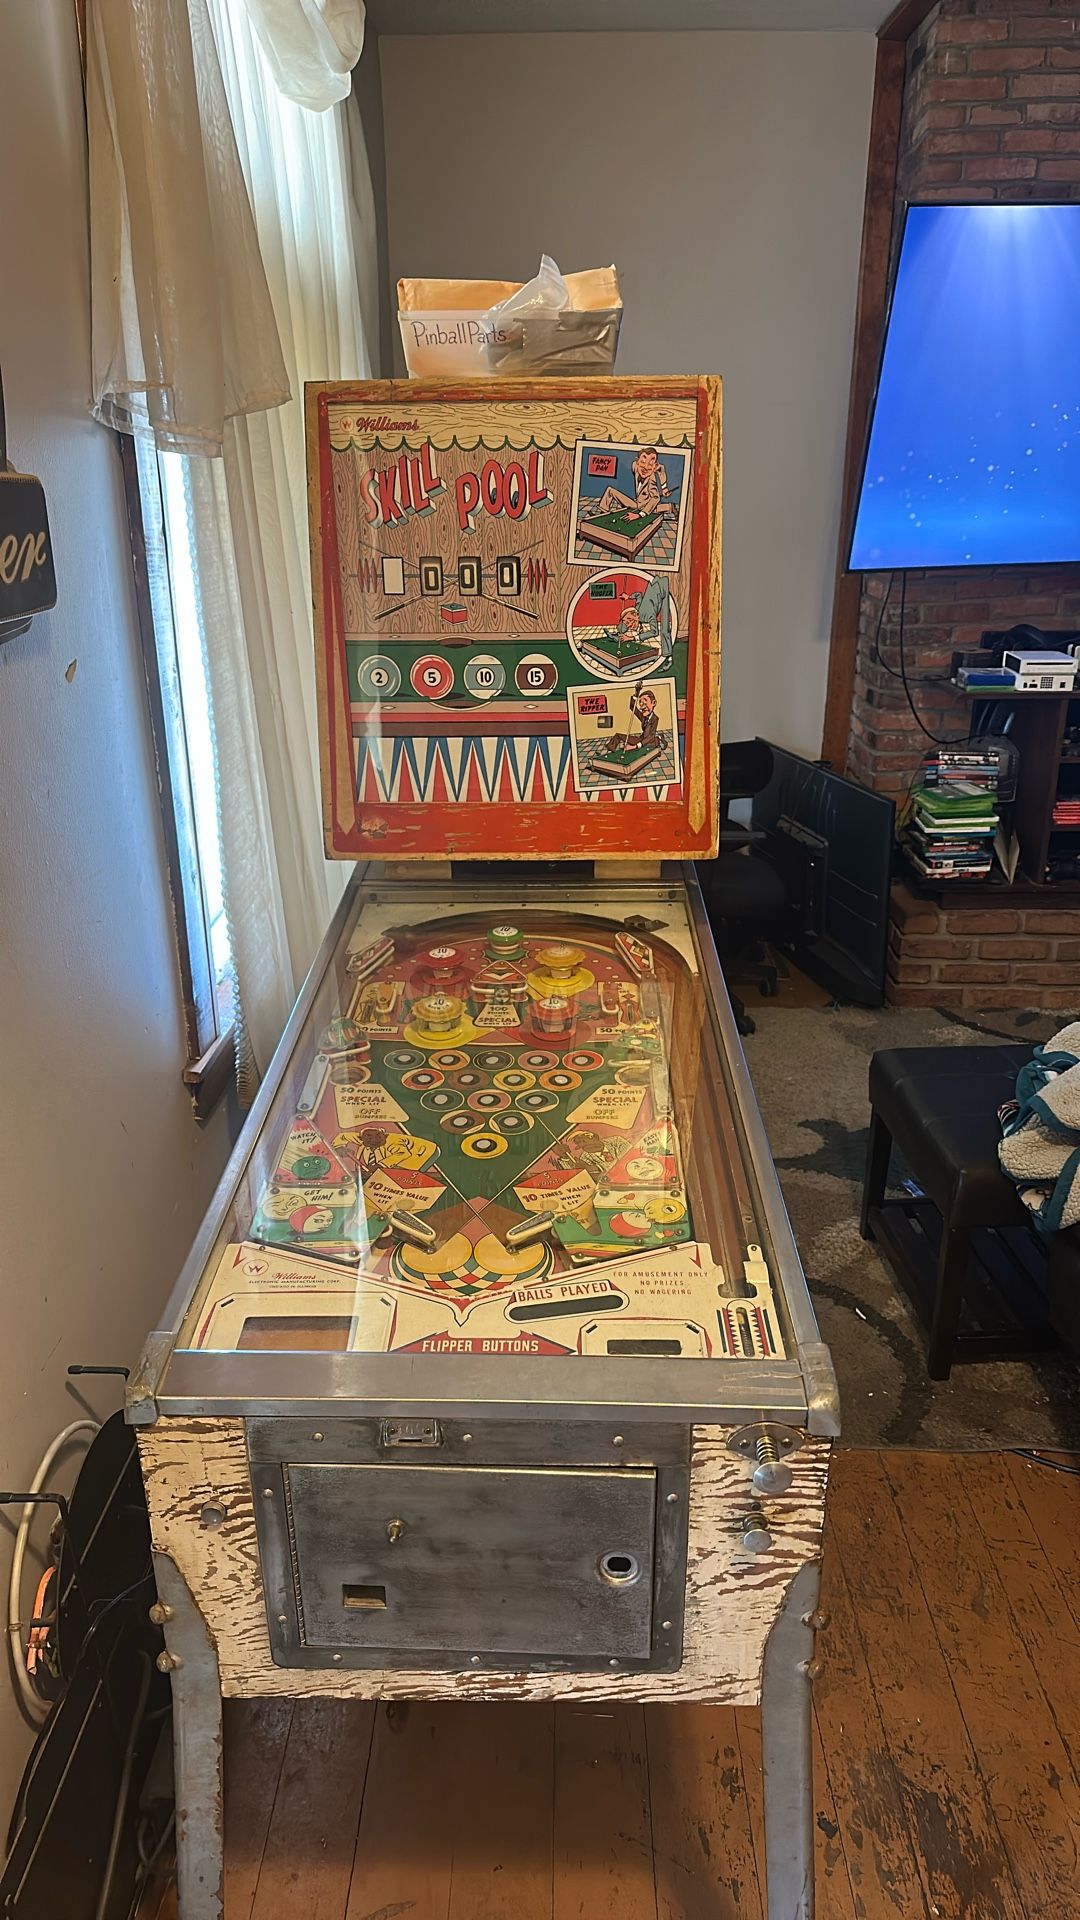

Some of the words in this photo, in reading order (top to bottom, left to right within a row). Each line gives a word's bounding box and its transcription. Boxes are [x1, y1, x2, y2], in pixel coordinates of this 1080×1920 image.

[411, 320, 467, 347] Pinball
[467, 320, 507, 345] Parts
[356, 416, 419, 432] Williams
[592, 457, 611, 465] FANCY
[595, 464, 608, 472] DAN
[360, 442, 447, 529] SKILL
[455, 450, 554, 535] POOL
[375, 671, 383, 684] 2
[428, 672, 436, 684] 5
[480, 670, 492, 684] 10
[531, 670, 541, 684] 15
[584, 697, 600, 705] THE
[580, 703, 606, 712] RIPPER
[290, 1132, 316, 1141] WATCH
[301, 1135, 317, 1145] IT!
[368, 1181, 384, 1191] 10
[383, 1186, 405, 1196] TIMES
[405, 1191, 429, 1202] VALUE
[373, 1192, 393, 1200] WHEN
[522, 1193, 538, 1203] 10
[540, 1190, 563, 1199] TIMES
[566, 1184, 591, 1194] VALUE
[311, 1192, 334, 1202] HIM!
[560, 1193, 581, 1201] WHEN
[272, 1272, 317, 1281] Williams
[518, 1288, 553, 1302] BALLS
[561, 1281, 608, 1297] PLAYED
[422, 1340, 472, 1352] FLIPPER
[482, 1340, 539, 1352] BUTTONS
